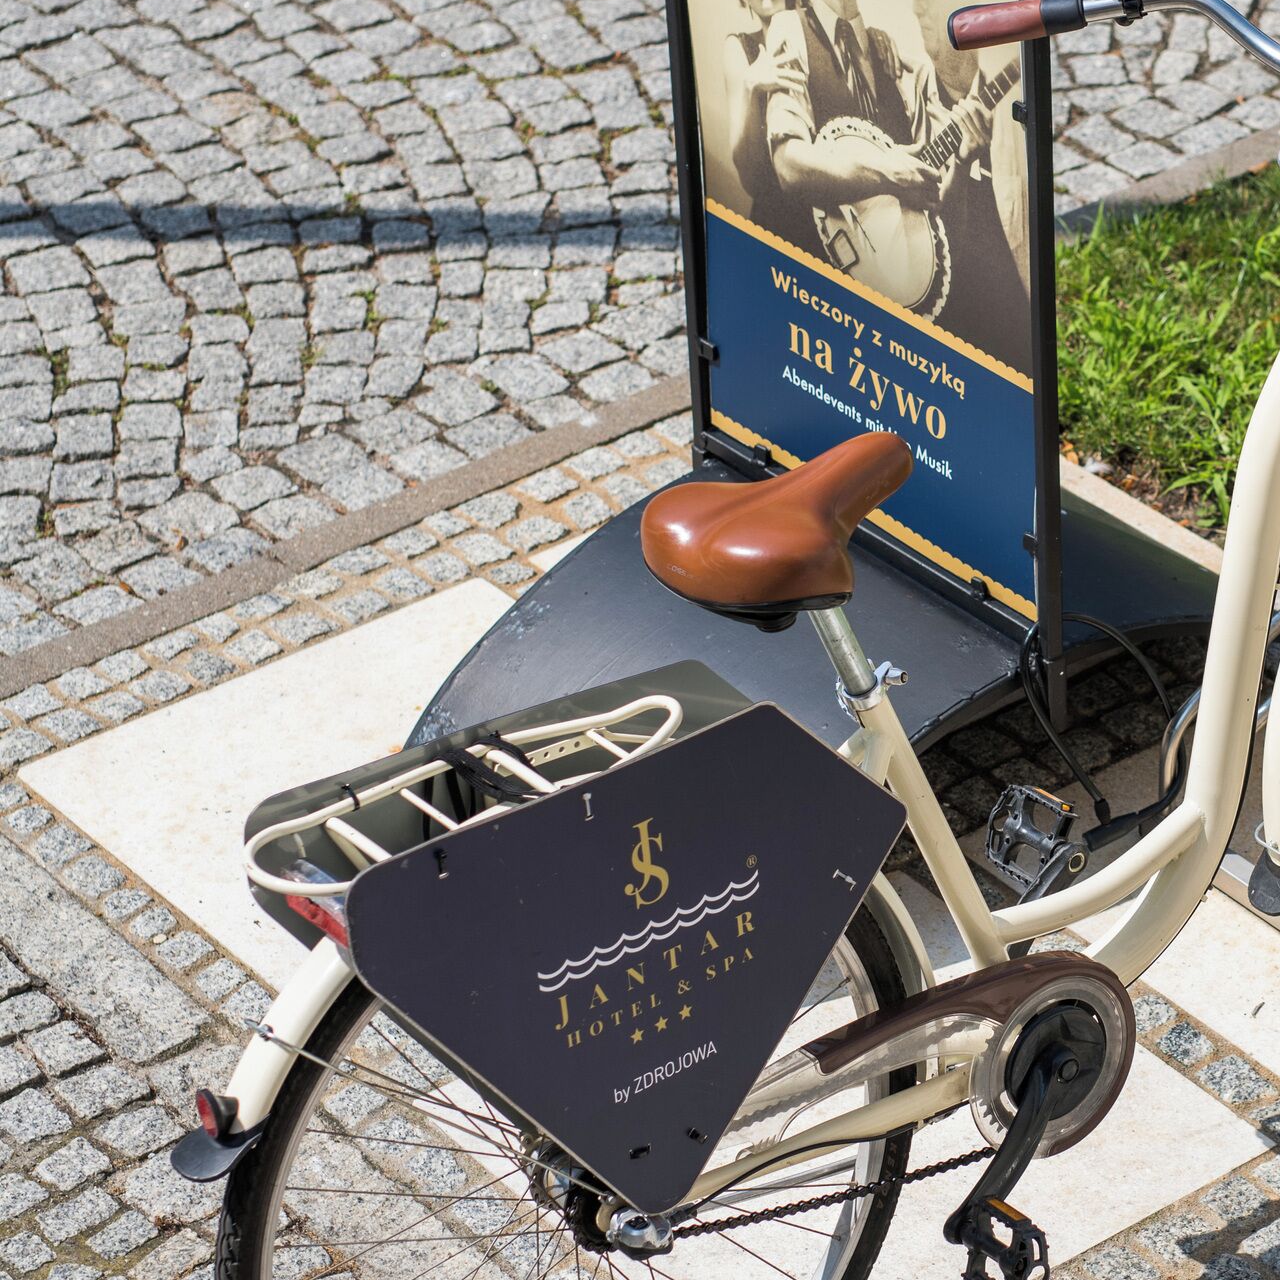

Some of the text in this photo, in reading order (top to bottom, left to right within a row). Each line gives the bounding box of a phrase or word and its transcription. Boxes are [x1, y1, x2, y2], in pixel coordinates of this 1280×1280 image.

[770, 266, 966, 400] Wieczory z muzyką
[788, 322, 947, 440] na żywo
[782, 365, 862, 423] Abendevents
[915, 443, 952, 480] Musik
[555, 911, 756, 1031] JANTAR
[566, 946, 755, 1049] HOTEL & SPA
[613, 1040, 718, 1104] by ZDROJOWA
